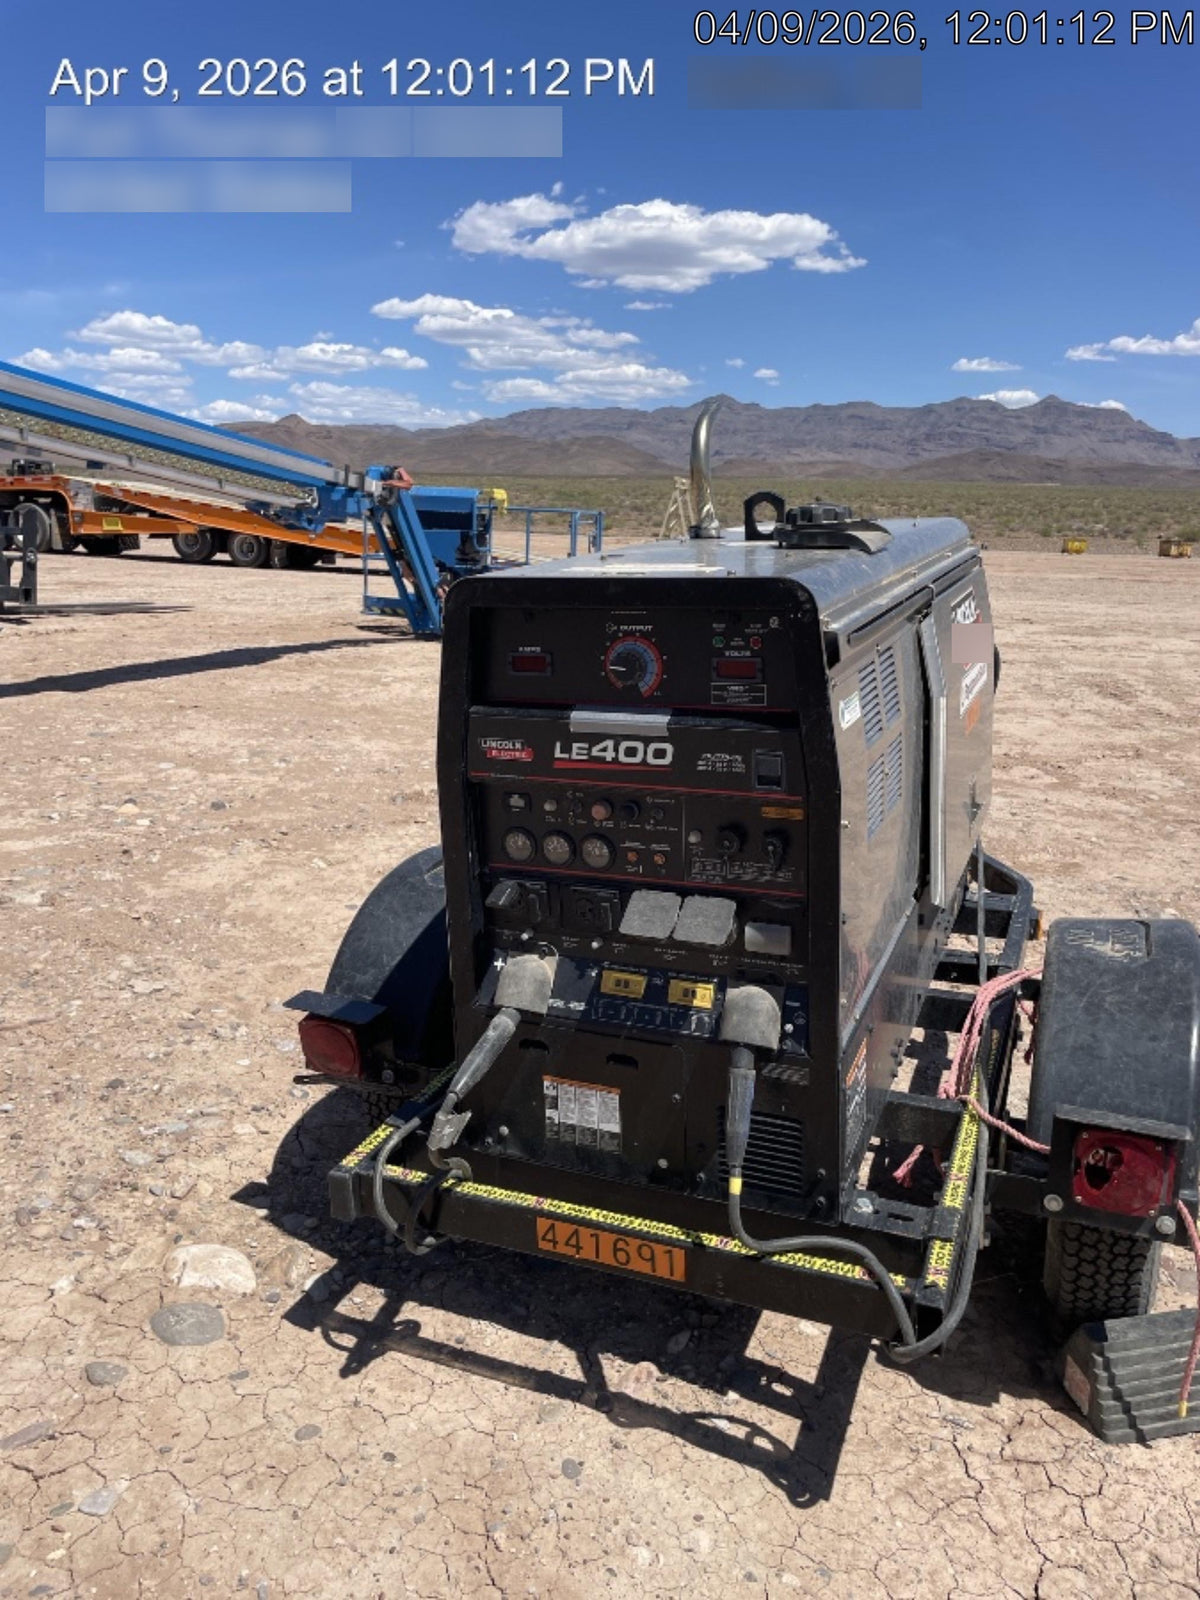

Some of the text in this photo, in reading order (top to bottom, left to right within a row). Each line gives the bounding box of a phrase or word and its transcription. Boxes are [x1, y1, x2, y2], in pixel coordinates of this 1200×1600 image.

[481, 739, 523, 751] LINCOLN
[554, 739, 674, 765] LE400
[541, 1222, 675, 1277] 441691
